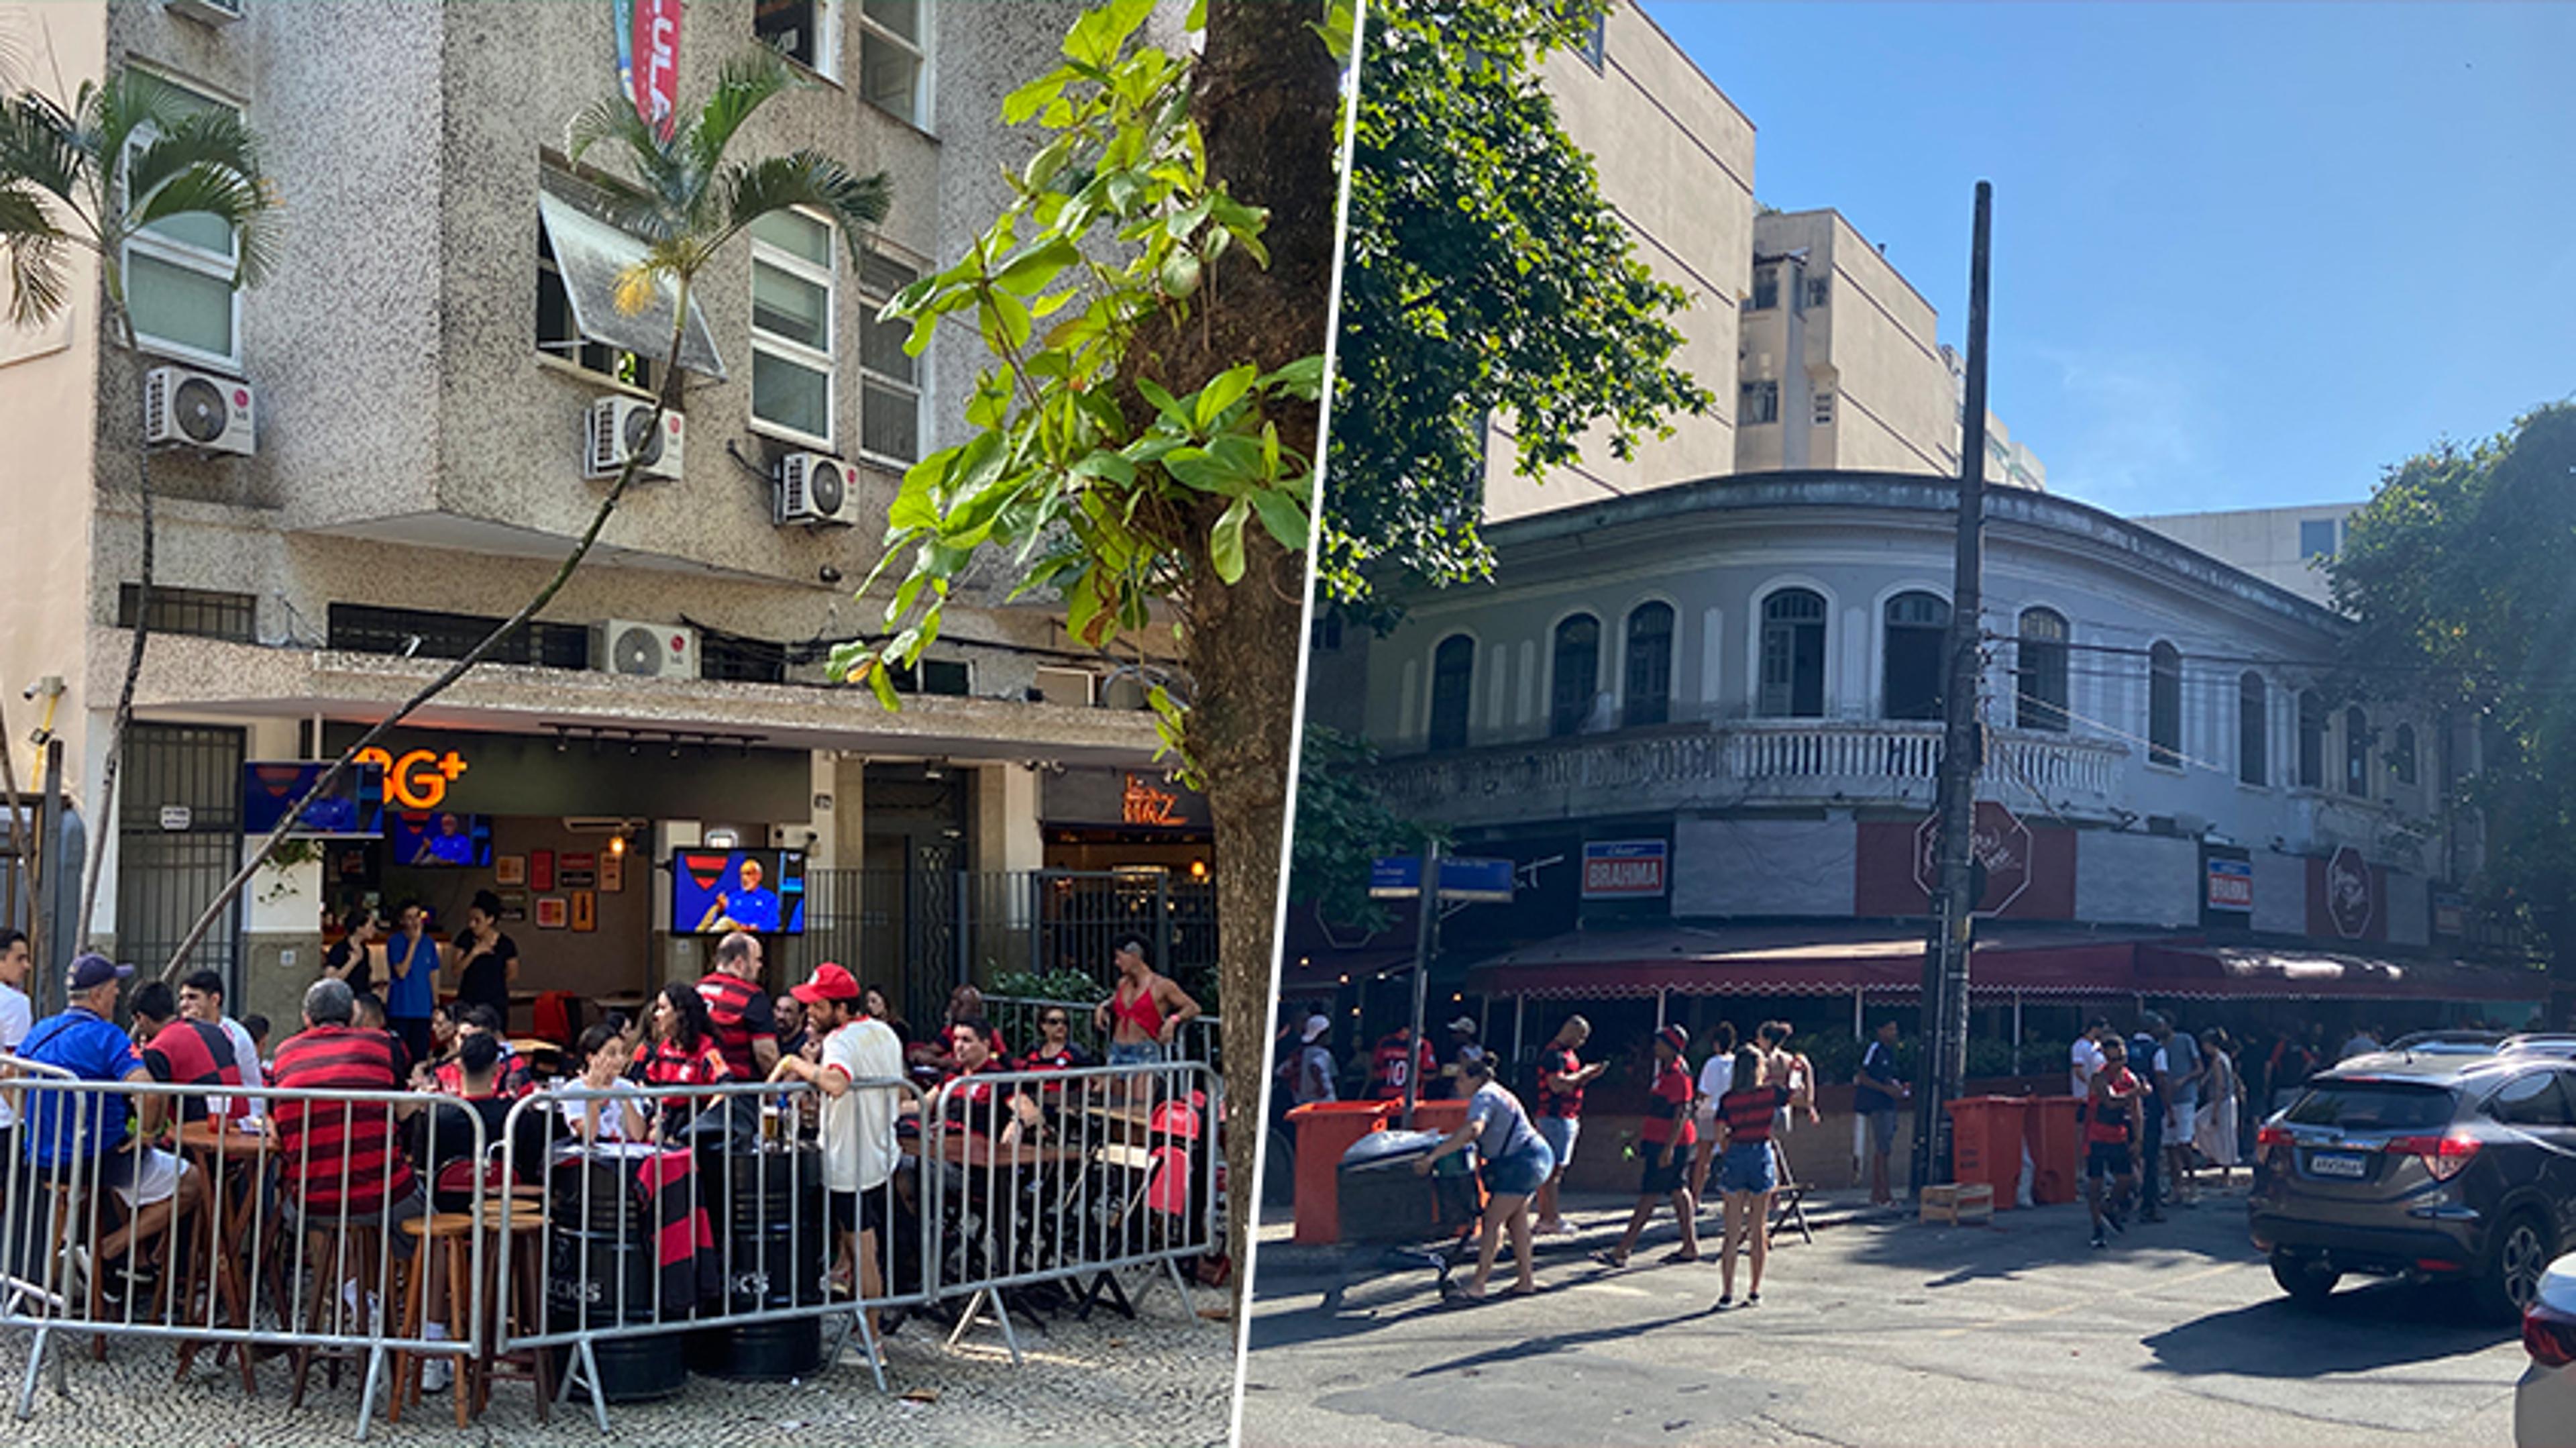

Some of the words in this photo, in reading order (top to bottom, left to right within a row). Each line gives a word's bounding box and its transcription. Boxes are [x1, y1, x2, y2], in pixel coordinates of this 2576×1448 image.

[649, 0, 673, 125] ULA
[1588, 862, 1658, 888] BRAHMA
[1387, 1061, 1407, 1086] 10
